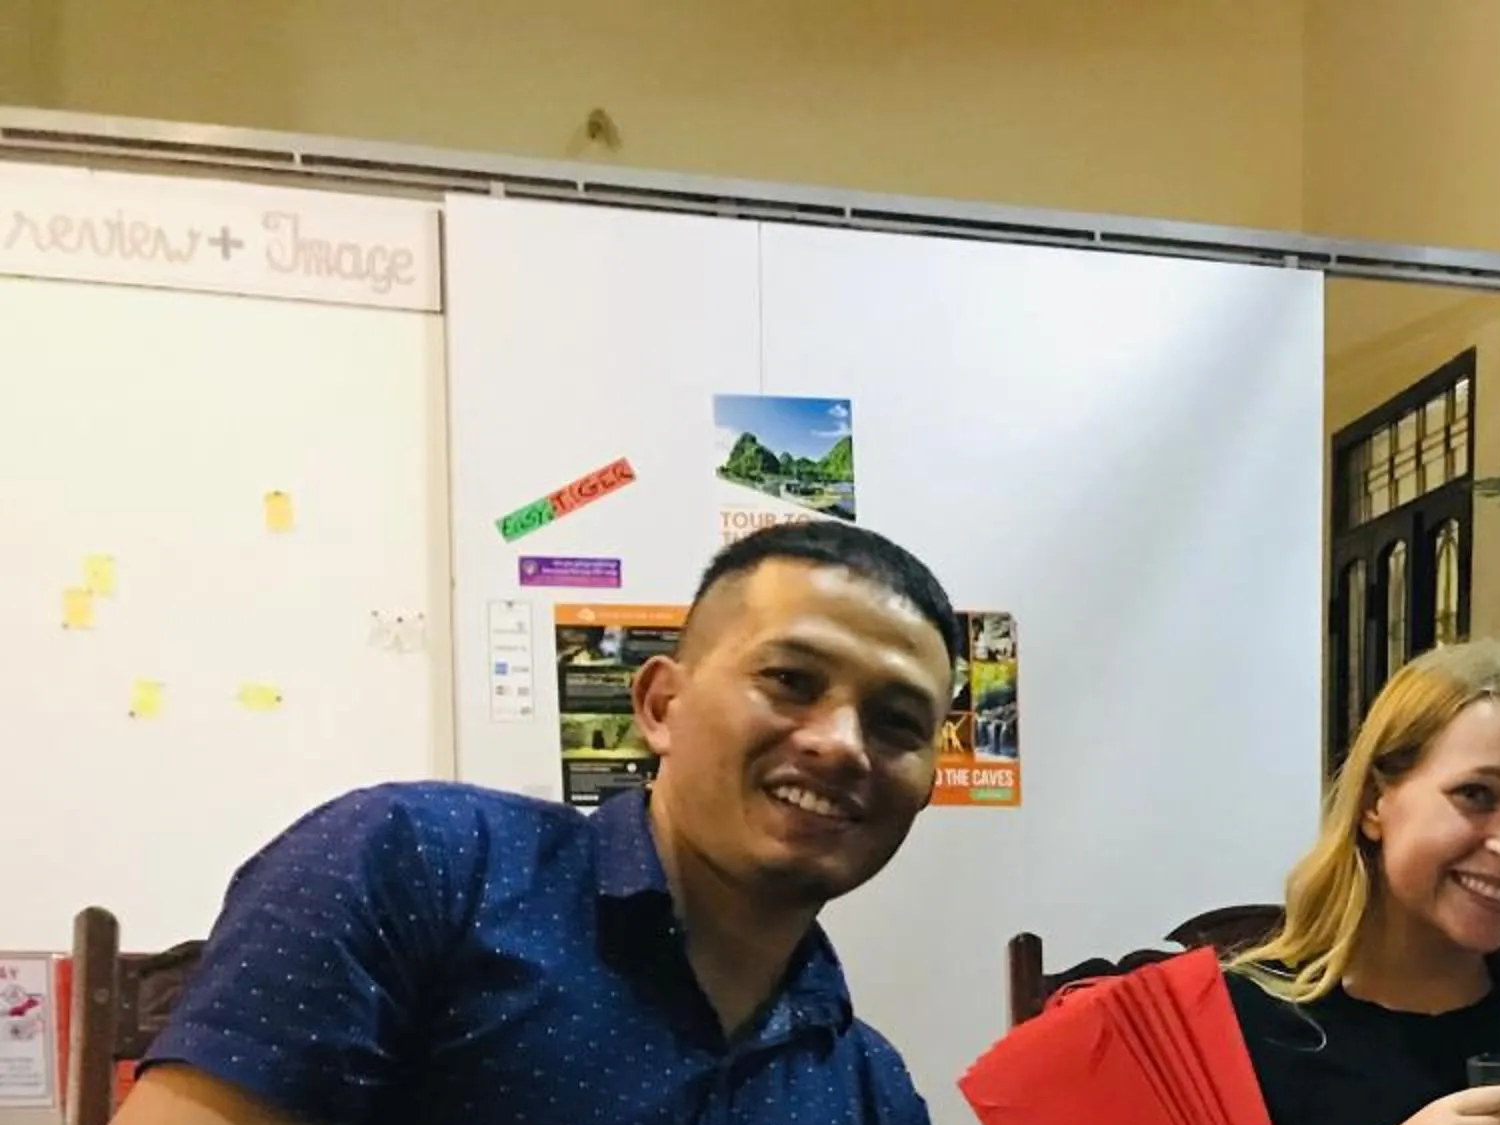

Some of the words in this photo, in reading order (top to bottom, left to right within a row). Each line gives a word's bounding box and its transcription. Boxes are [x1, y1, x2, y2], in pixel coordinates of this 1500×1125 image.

[4, 209, 201, 263] review
[261, 210, 416, 294] Image
[944, 768, 970, 787] THE
[972, 768, 1014, 787] CAVES
